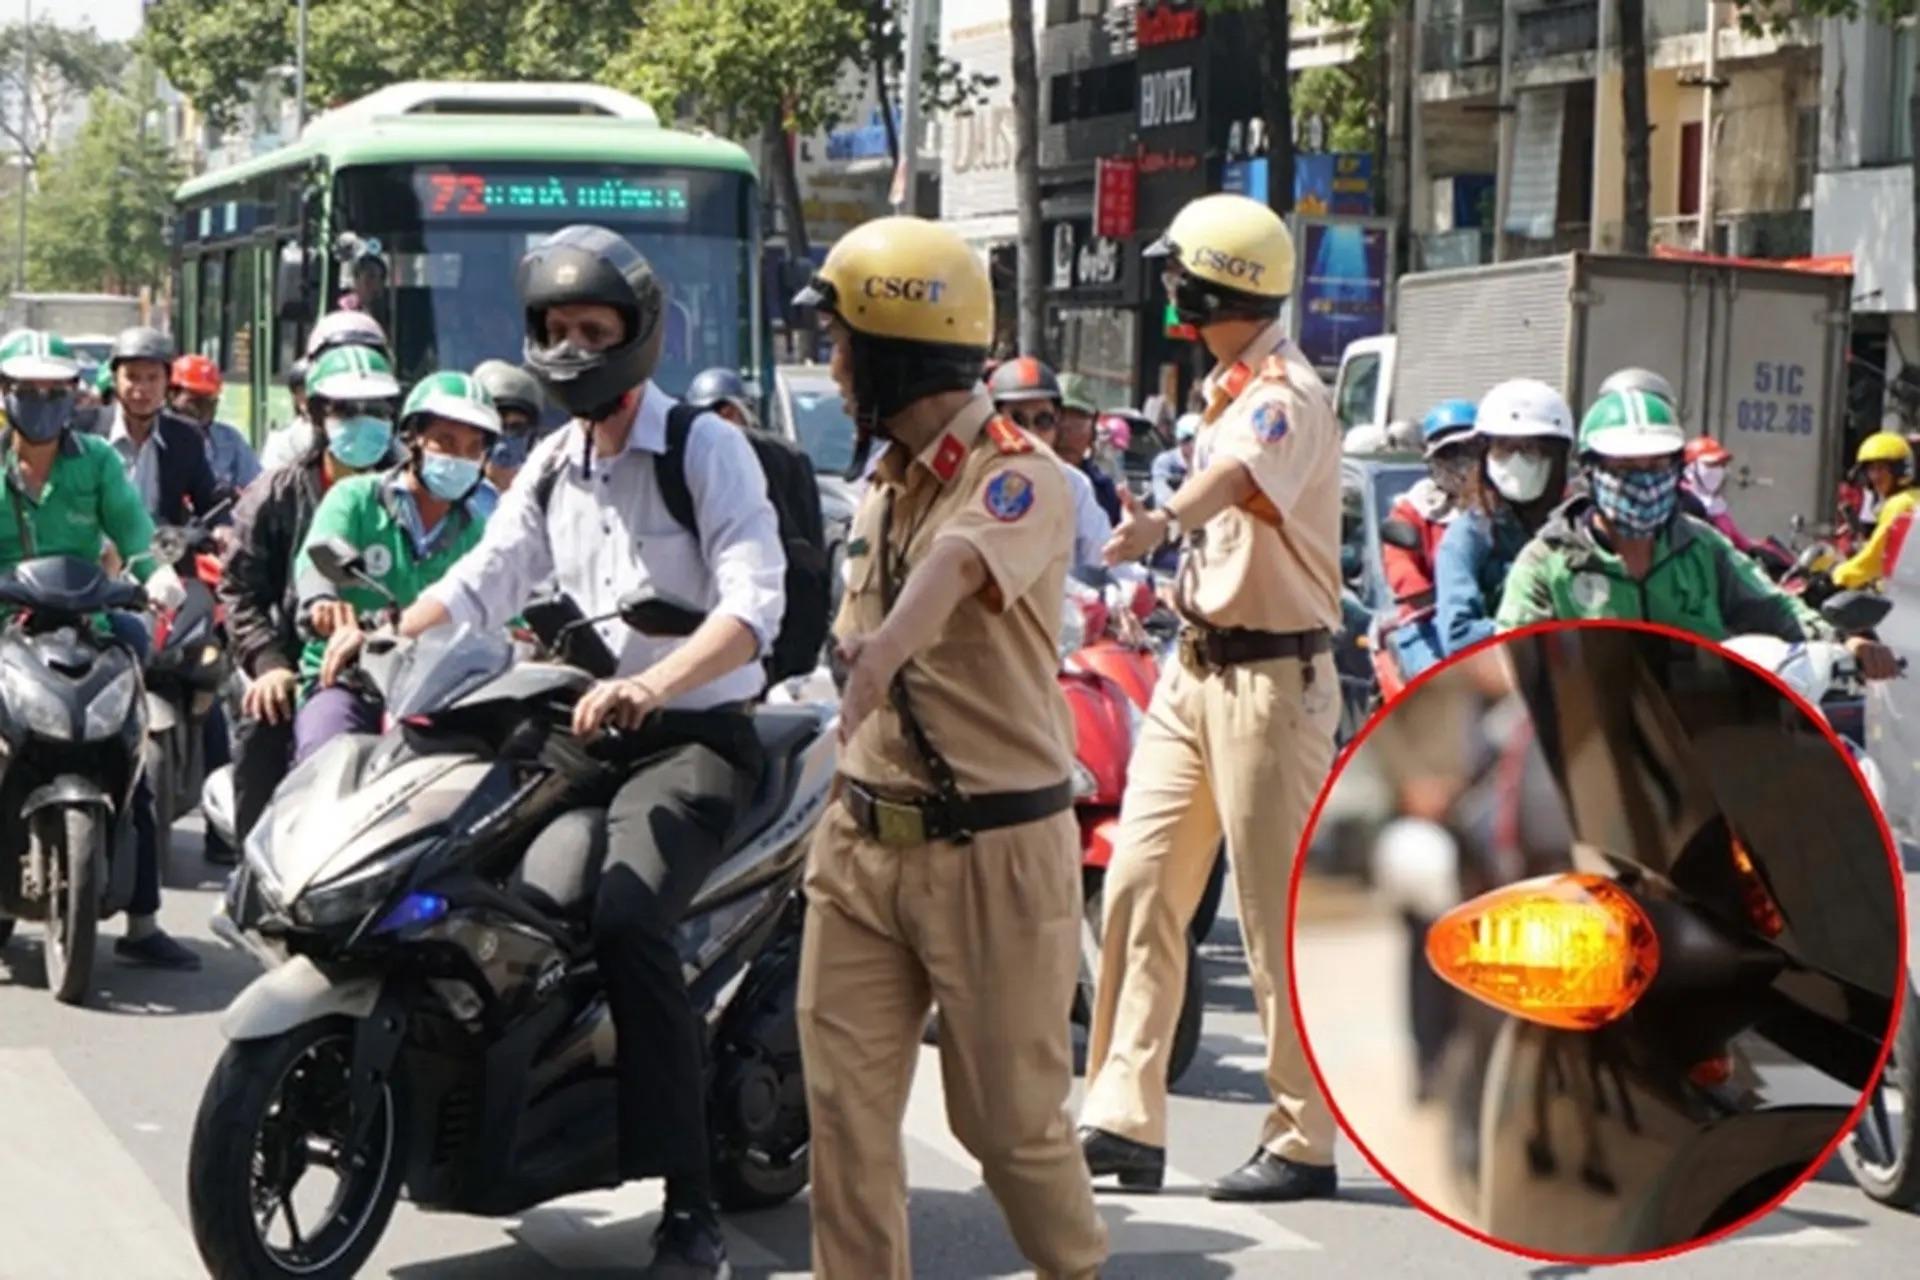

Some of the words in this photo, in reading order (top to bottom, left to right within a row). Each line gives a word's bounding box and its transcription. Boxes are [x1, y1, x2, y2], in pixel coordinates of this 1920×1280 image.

[1140, 66, 1196, 127] HOTEL
[430, 174, 487, 214] 72
[1194, 246, 1265, 286] CSGT
[864, 275, 947, 303] CSGT
[1754, 361, 1805, 396] 51C
